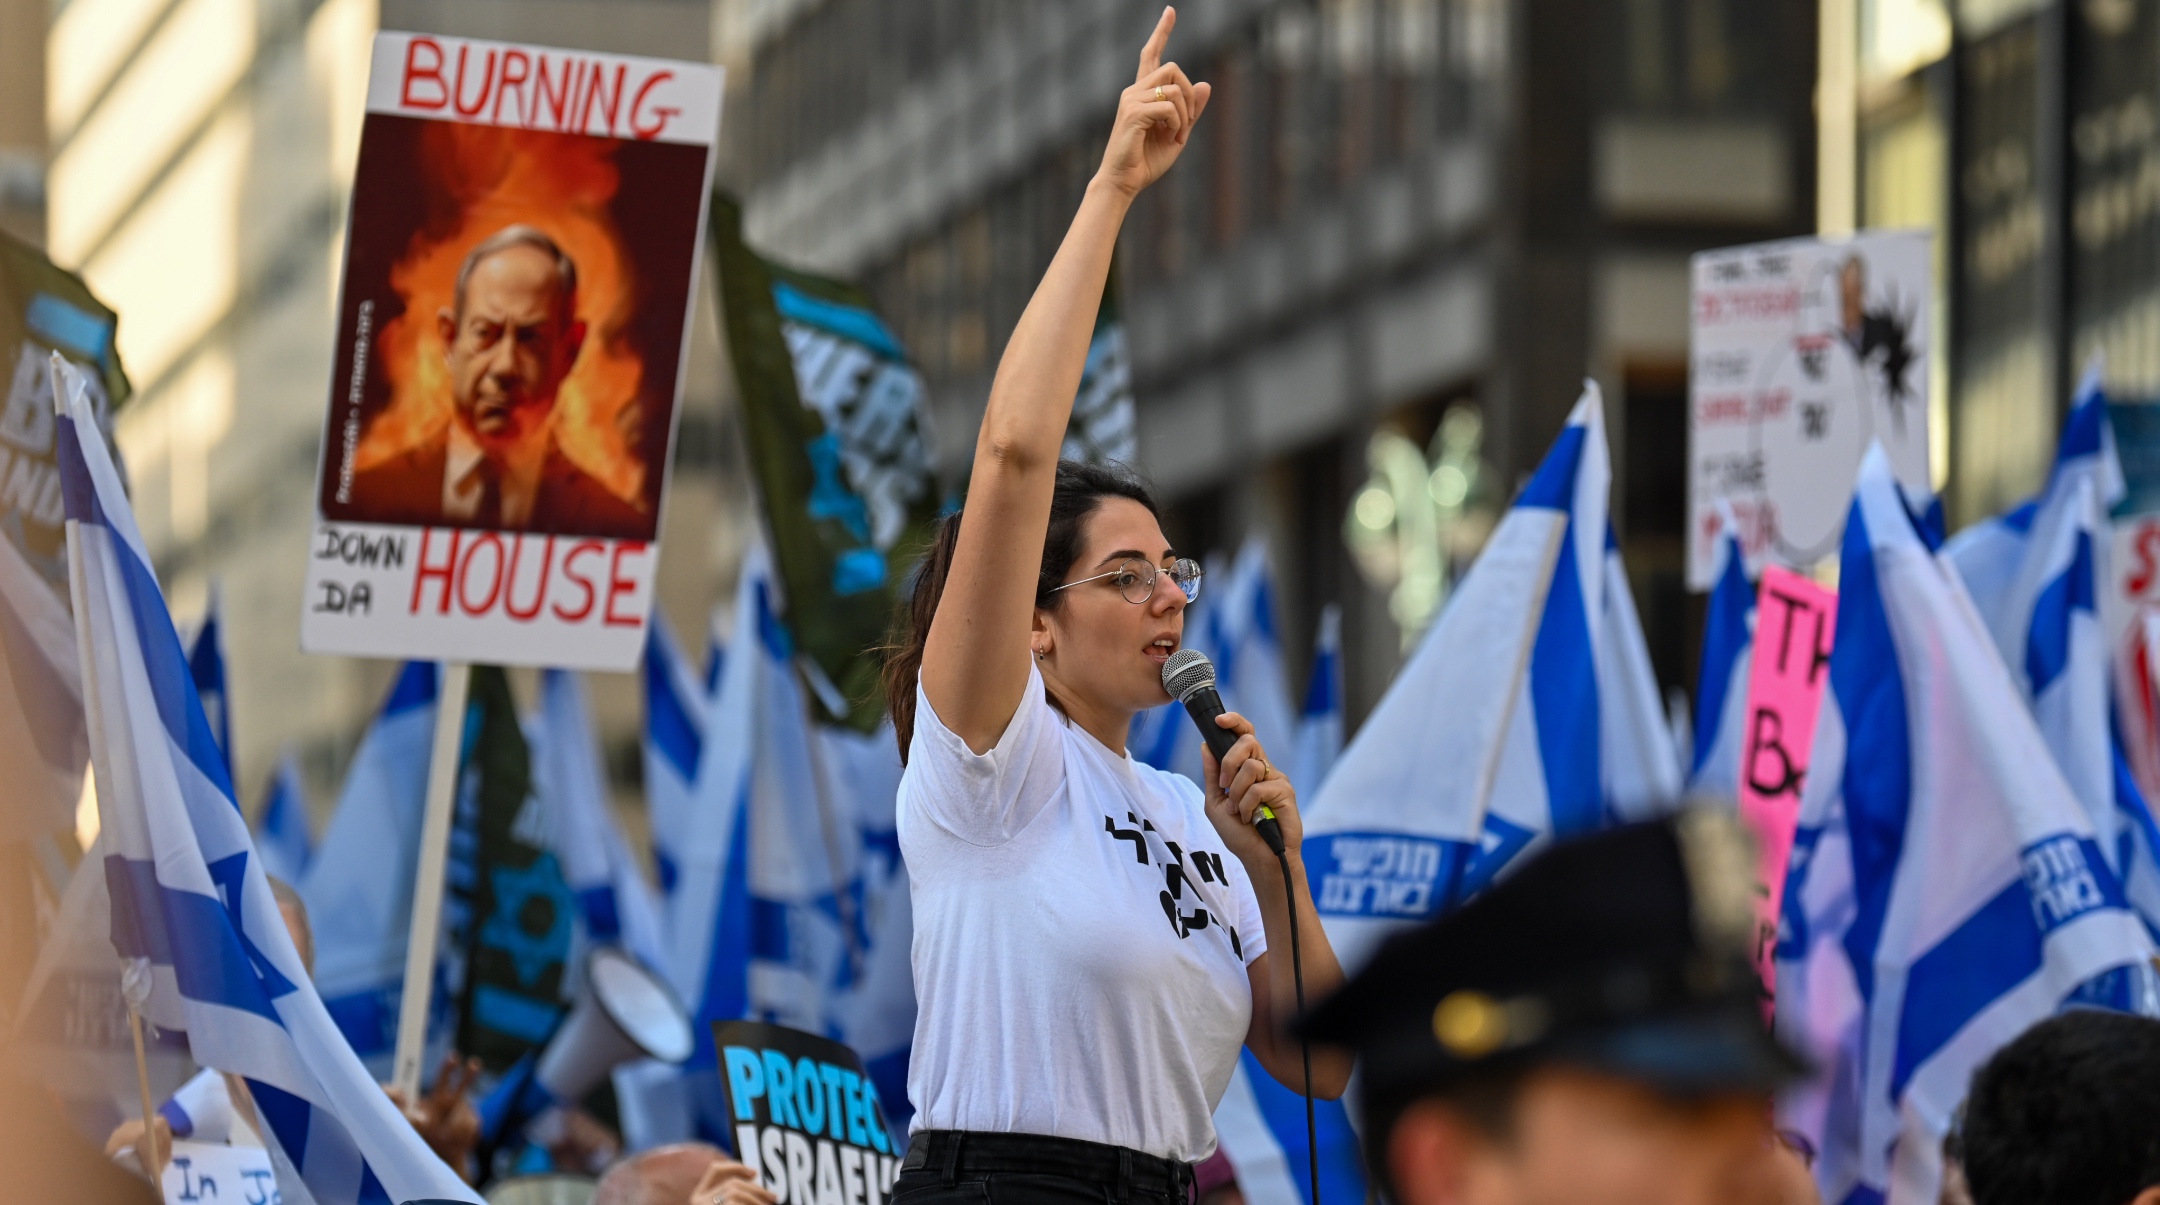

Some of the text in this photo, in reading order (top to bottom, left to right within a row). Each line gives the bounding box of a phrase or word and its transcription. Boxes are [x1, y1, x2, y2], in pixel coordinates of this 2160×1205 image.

[398, 36, 684, 140] BURNING
[312, 581, 373, 616] DA
[315, 525, 647, 628] DOWN HOUSE
[1331, 837, 1442, 880] חופשי
[1320, 874, 1433, 914] בארצנו
[172, 1157, 217, 1203] In
